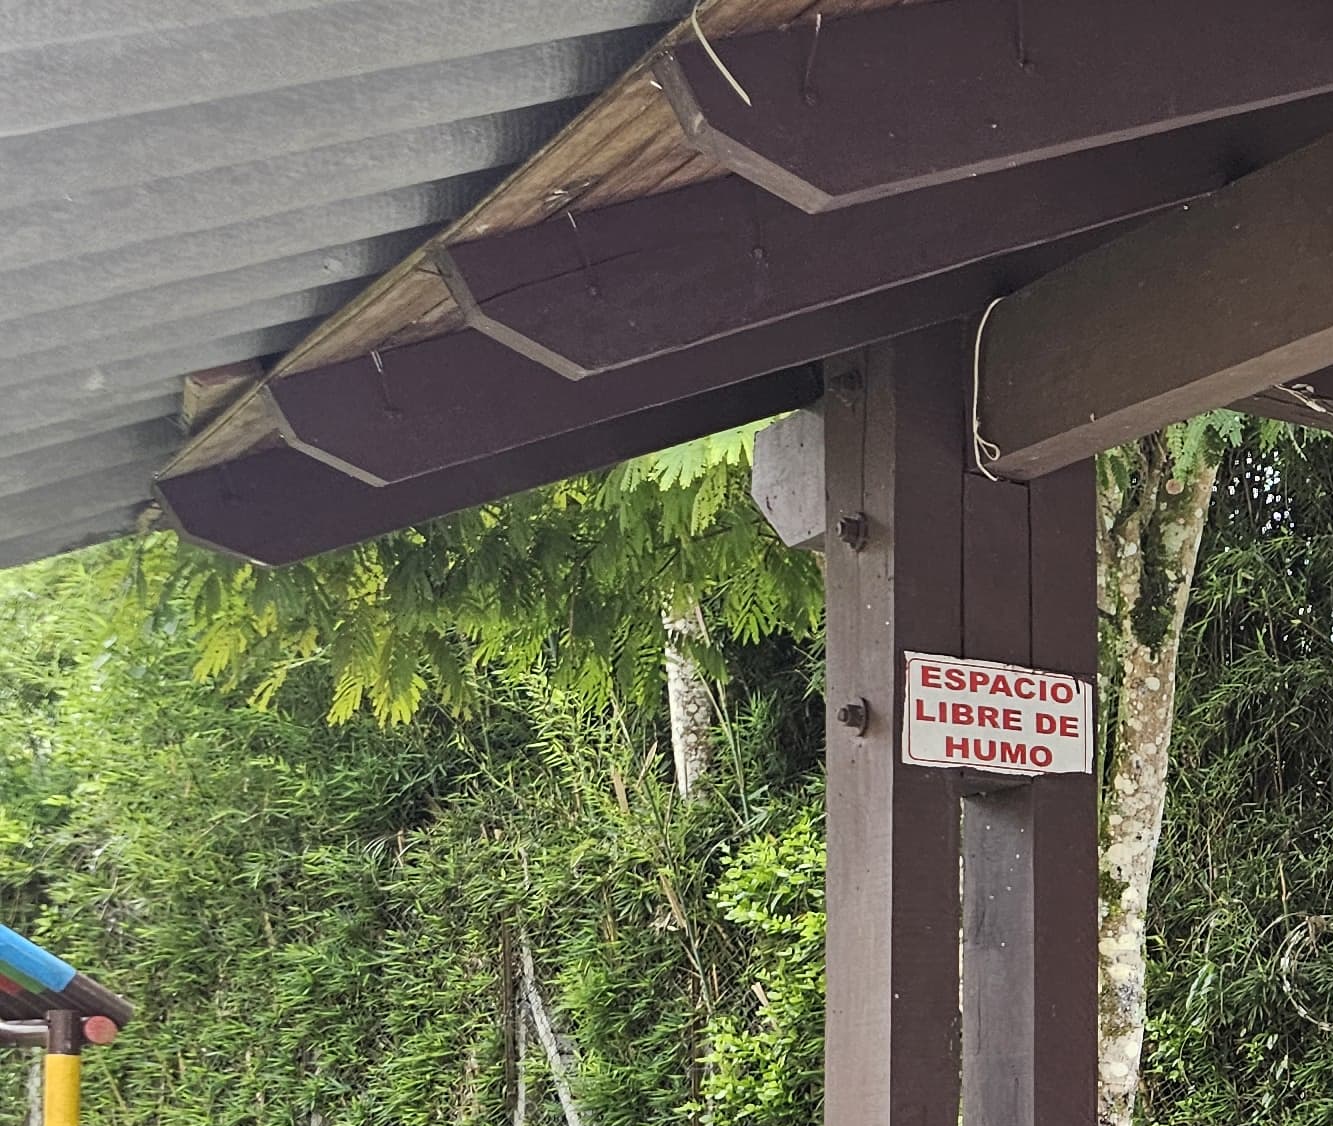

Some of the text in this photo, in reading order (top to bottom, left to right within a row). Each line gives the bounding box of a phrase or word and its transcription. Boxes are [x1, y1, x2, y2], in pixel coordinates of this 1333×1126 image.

[920, 665, 1074, 704] ESPACIO
[915, 699, 1080, 738] LIBRE DE
[945, 736, 1053, 767] HUMO
